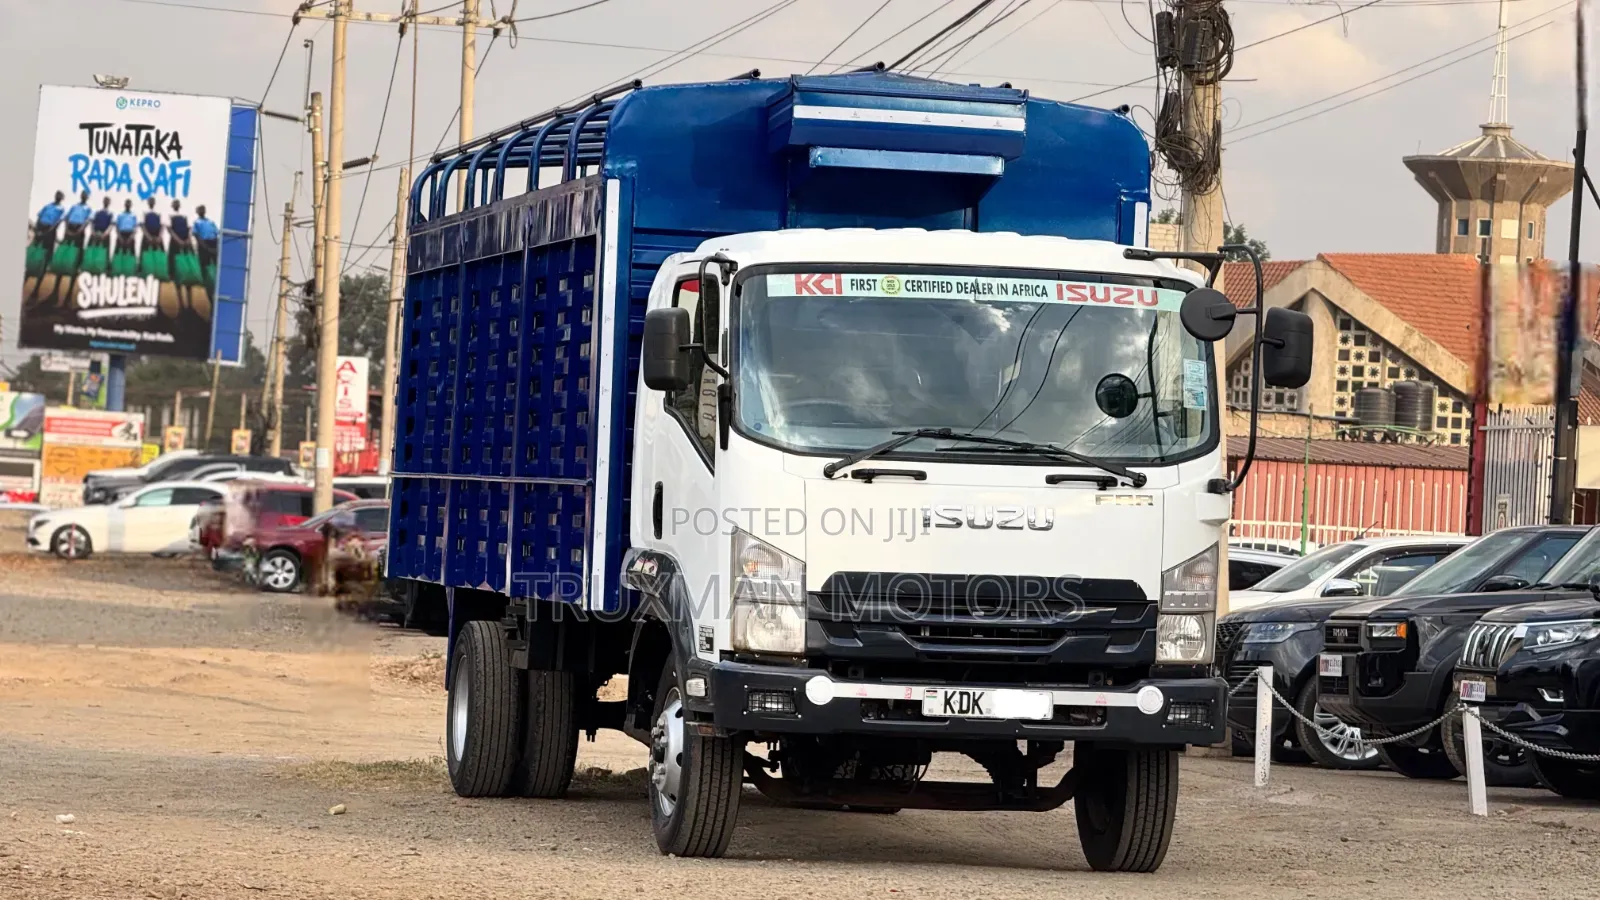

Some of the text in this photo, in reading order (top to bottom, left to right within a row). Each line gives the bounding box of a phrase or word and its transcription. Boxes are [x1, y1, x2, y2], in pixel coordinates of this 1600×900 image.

[129, 98, 161, 108] KEPRO
[68, 153, 191, 200] RADA SAFI
[77, 271, 159, 309] SHULENI
[794, 274, 1159, 307] KCI FIRST CERTIFIED DEALER IN AFRICA ISUZU
[922, 504, 1055, 532] ISUZU
[942, 690, 986, 715] KDK
